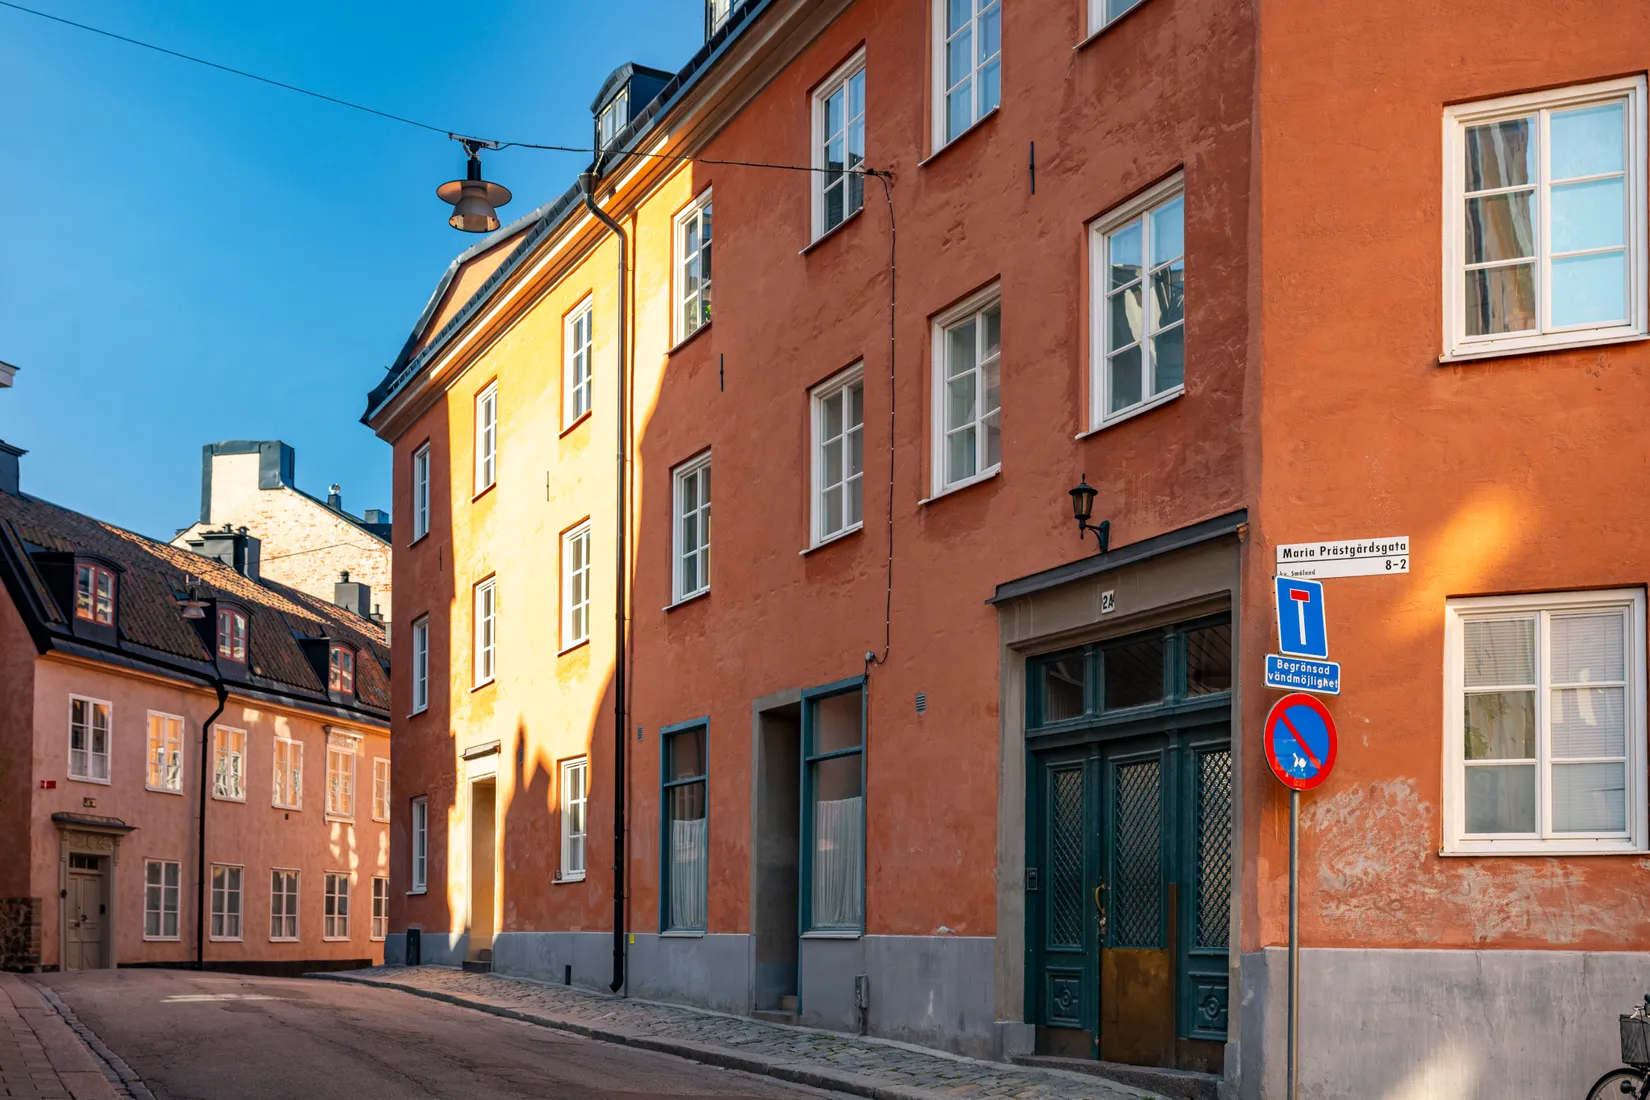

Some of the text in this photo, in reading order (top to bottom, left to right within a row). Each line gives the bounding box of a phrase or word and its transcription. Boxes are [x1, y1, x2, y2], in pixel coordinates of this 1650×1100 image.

[1283, 541, 1406, 559] Maria Prästgårdsgata
[1277, 660, 1330, 675] Begränsad
[1267, 671, 1338, 688] vändmöjlighet
